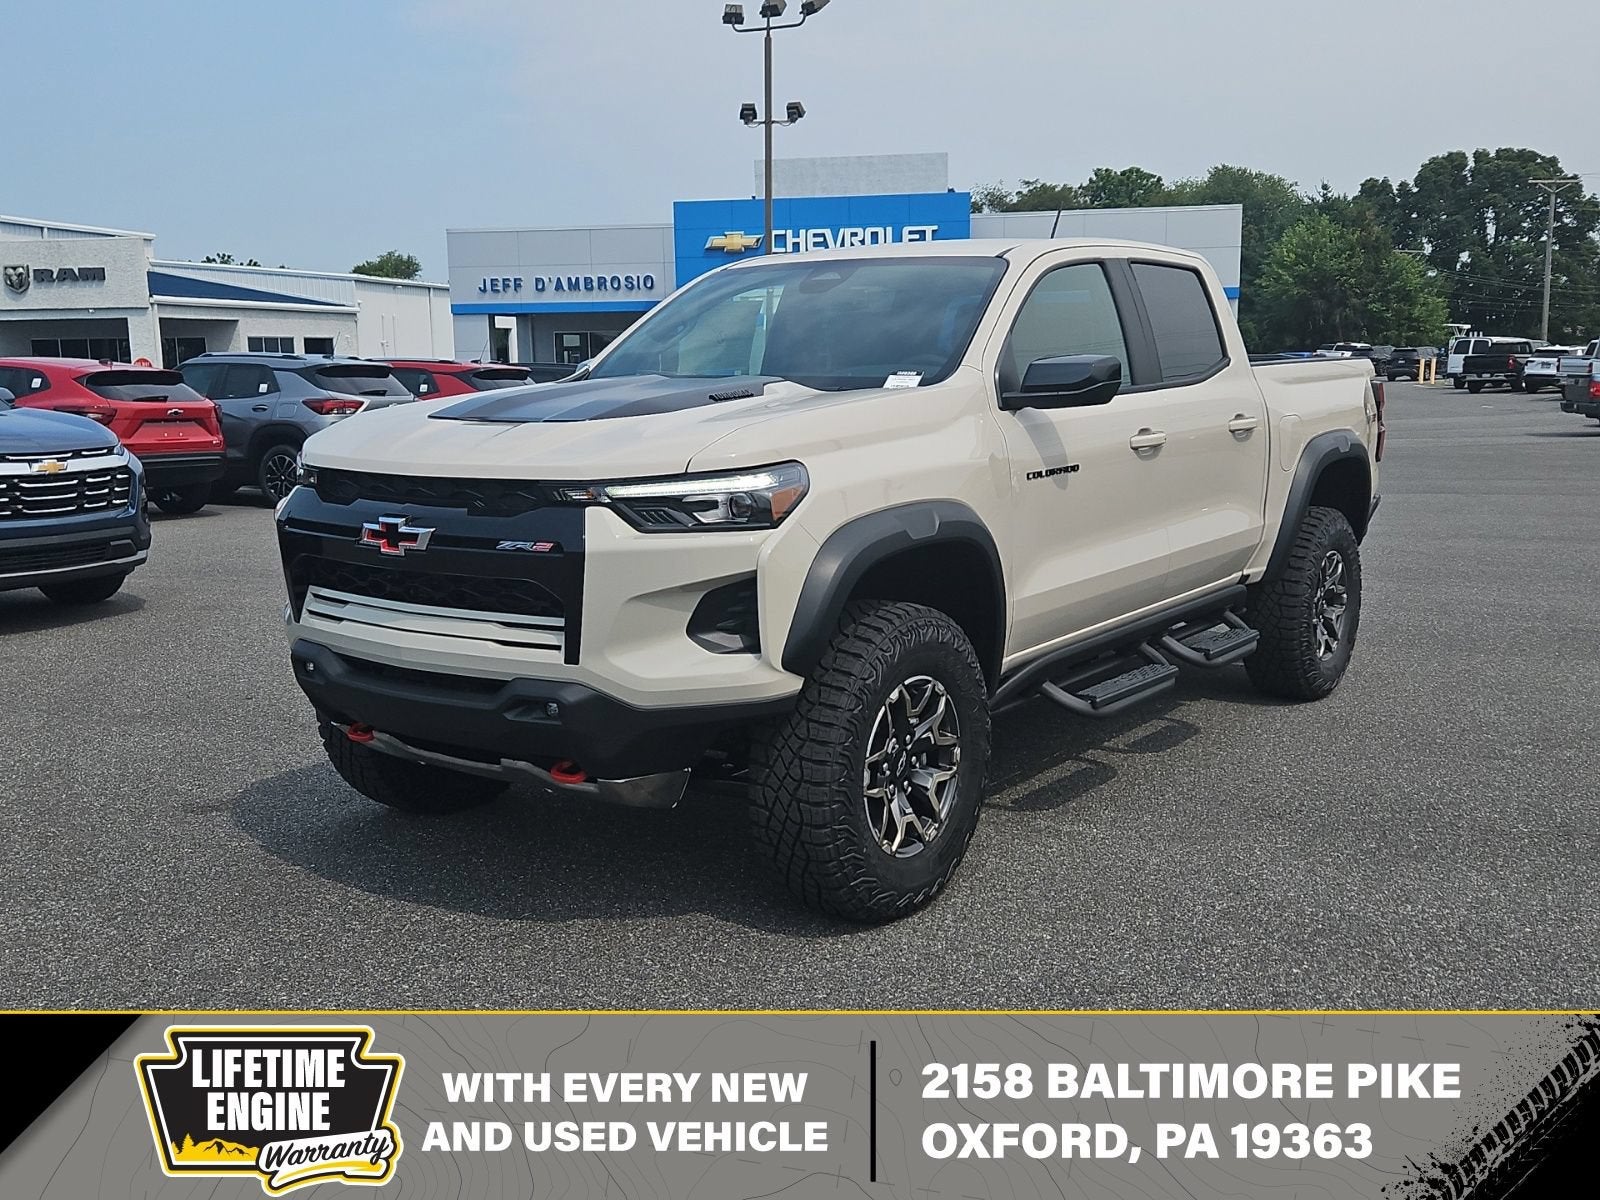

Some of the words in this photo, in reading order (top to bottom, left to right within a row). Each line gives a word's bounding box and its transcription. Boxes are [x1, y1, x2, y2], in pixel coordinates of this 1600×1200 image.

[770, 225, 938, 253] CHEVROLET
[33, 267, 106, 283] RAM
[478, 277, 522, 294] JEFF
[534, 274, 655, 293] D'AMBROSIO
[1026, 464, 1080, 480] COLORADO
[495, 540, 554, 552] ZR2
